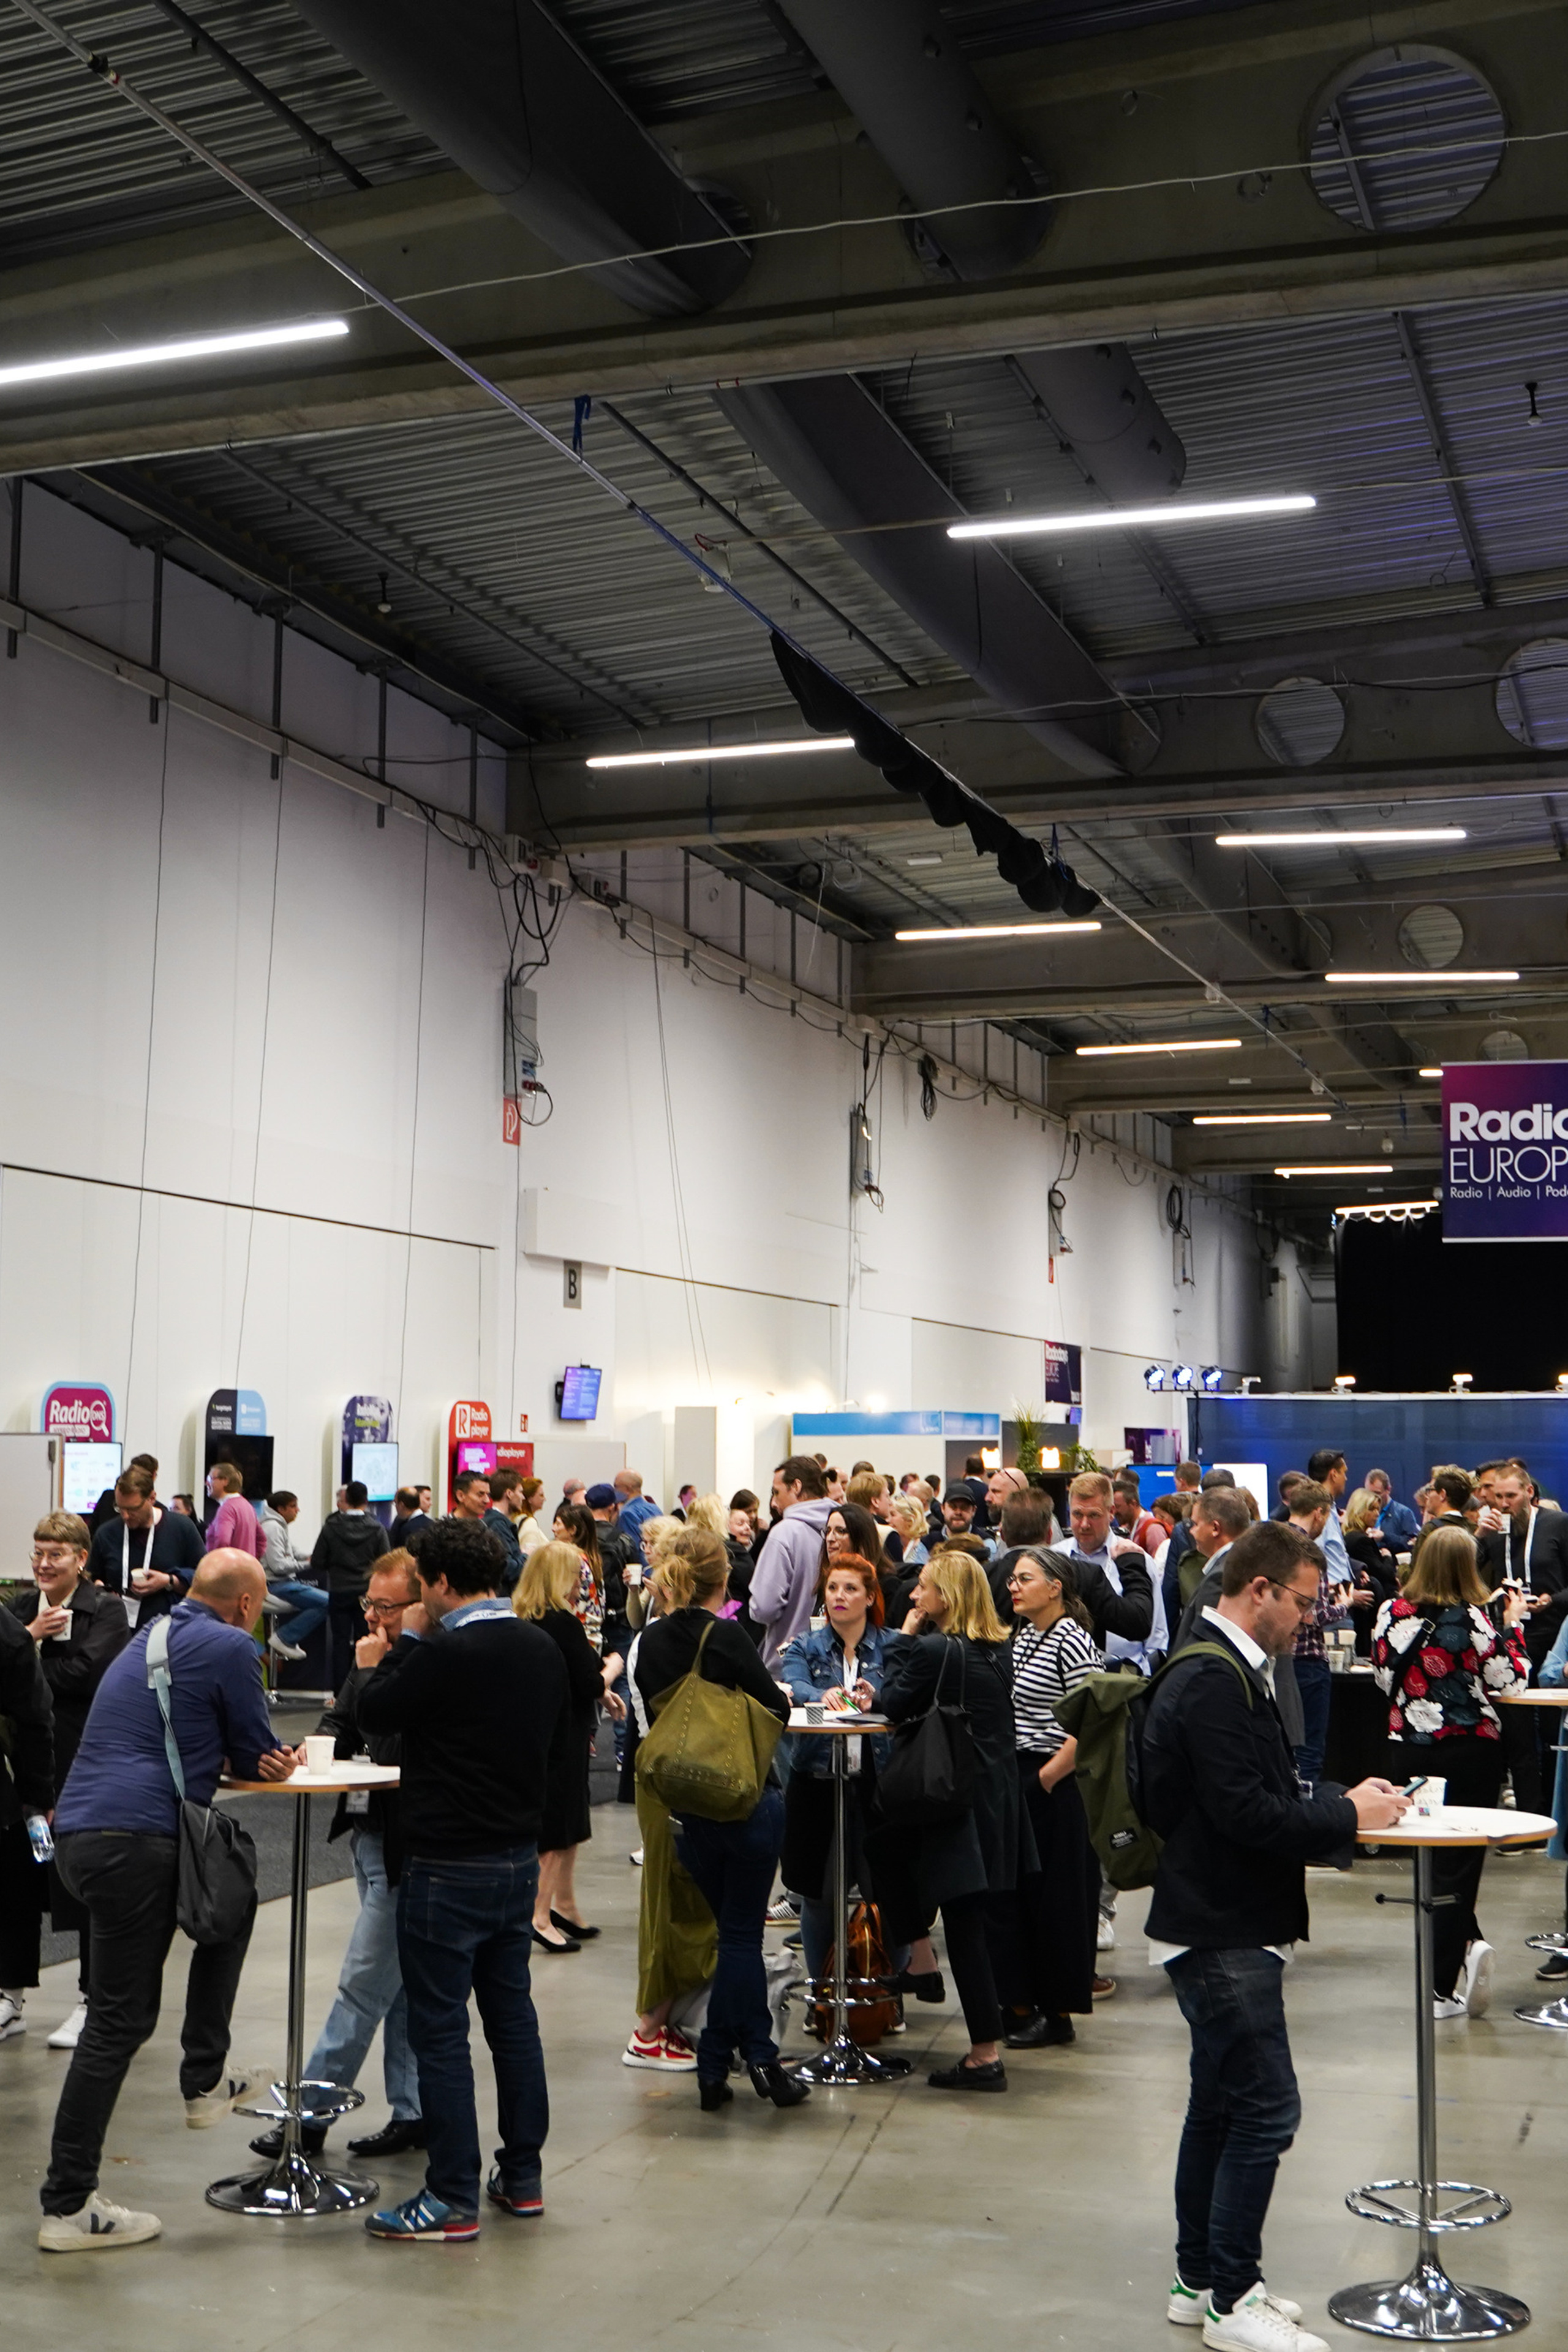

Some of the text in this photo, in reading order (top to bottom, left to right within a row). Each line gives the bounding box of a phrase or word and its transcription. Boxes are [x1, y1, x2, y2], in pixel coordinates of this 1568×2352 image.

[1450, 1147, 1568, 1183] EUROP
[1450, 1185, 1568, 1198] Radio Audio Pod
[568, 1269, 577, 1299] B
[50, 1400, 90, 1423] Radio
[471, 1408, 488, 1421] Radio
[471, 1423, 489, 1438] player
